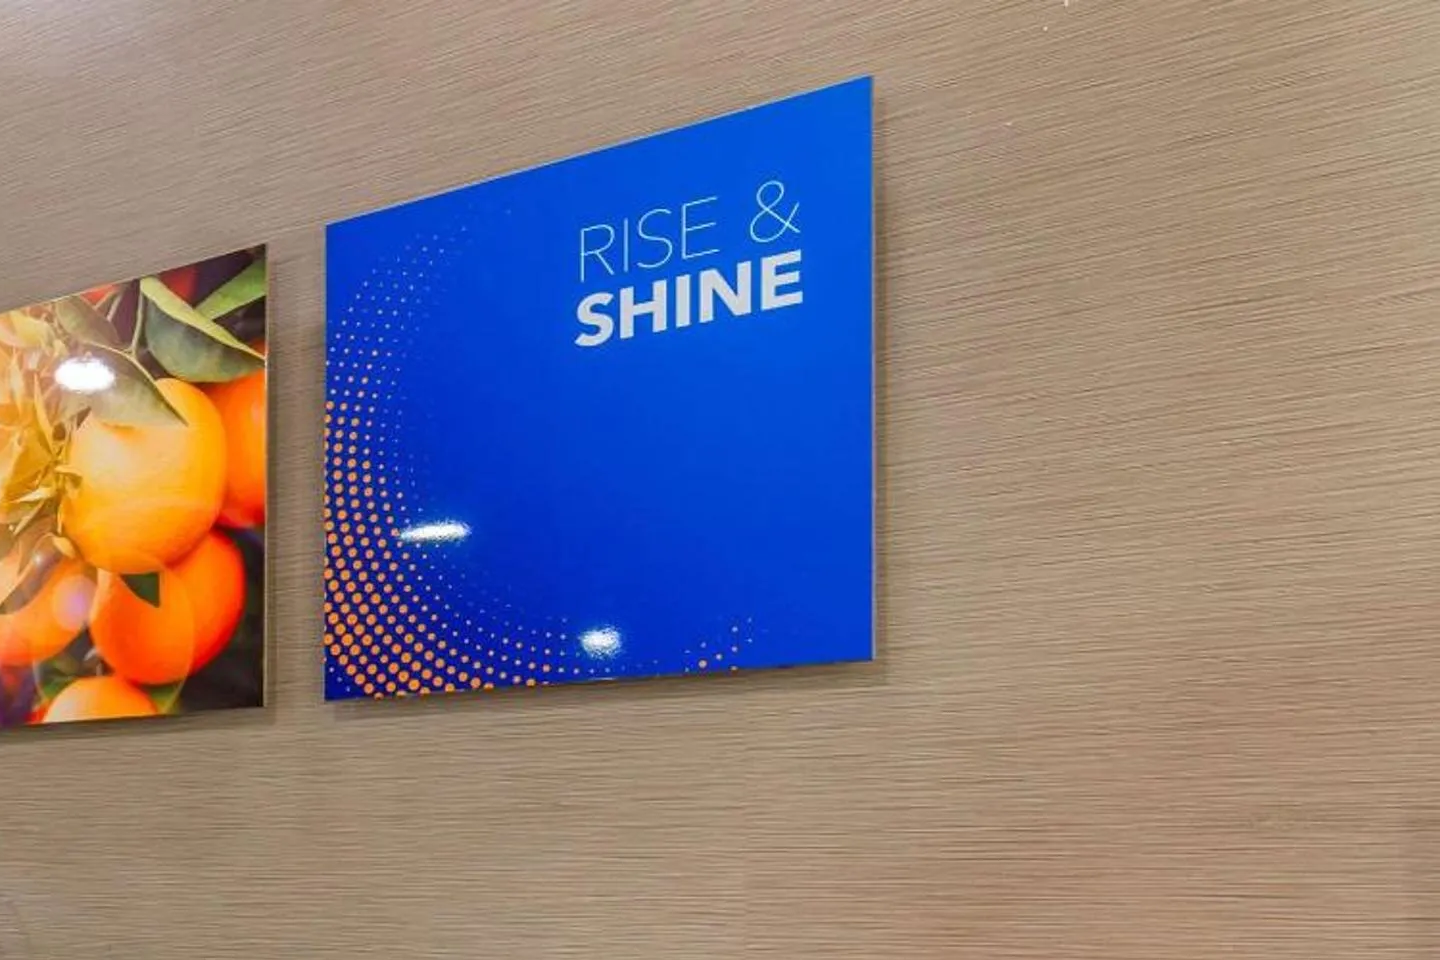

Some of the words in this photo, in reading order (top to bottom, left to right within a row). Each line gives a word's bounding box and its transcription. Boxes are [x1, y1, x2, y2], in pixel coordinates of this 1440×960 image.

[580, 196, 720, 283] RISE
[750, 180, 801, 243] &
[574, 249, 803, 347] SHINE
